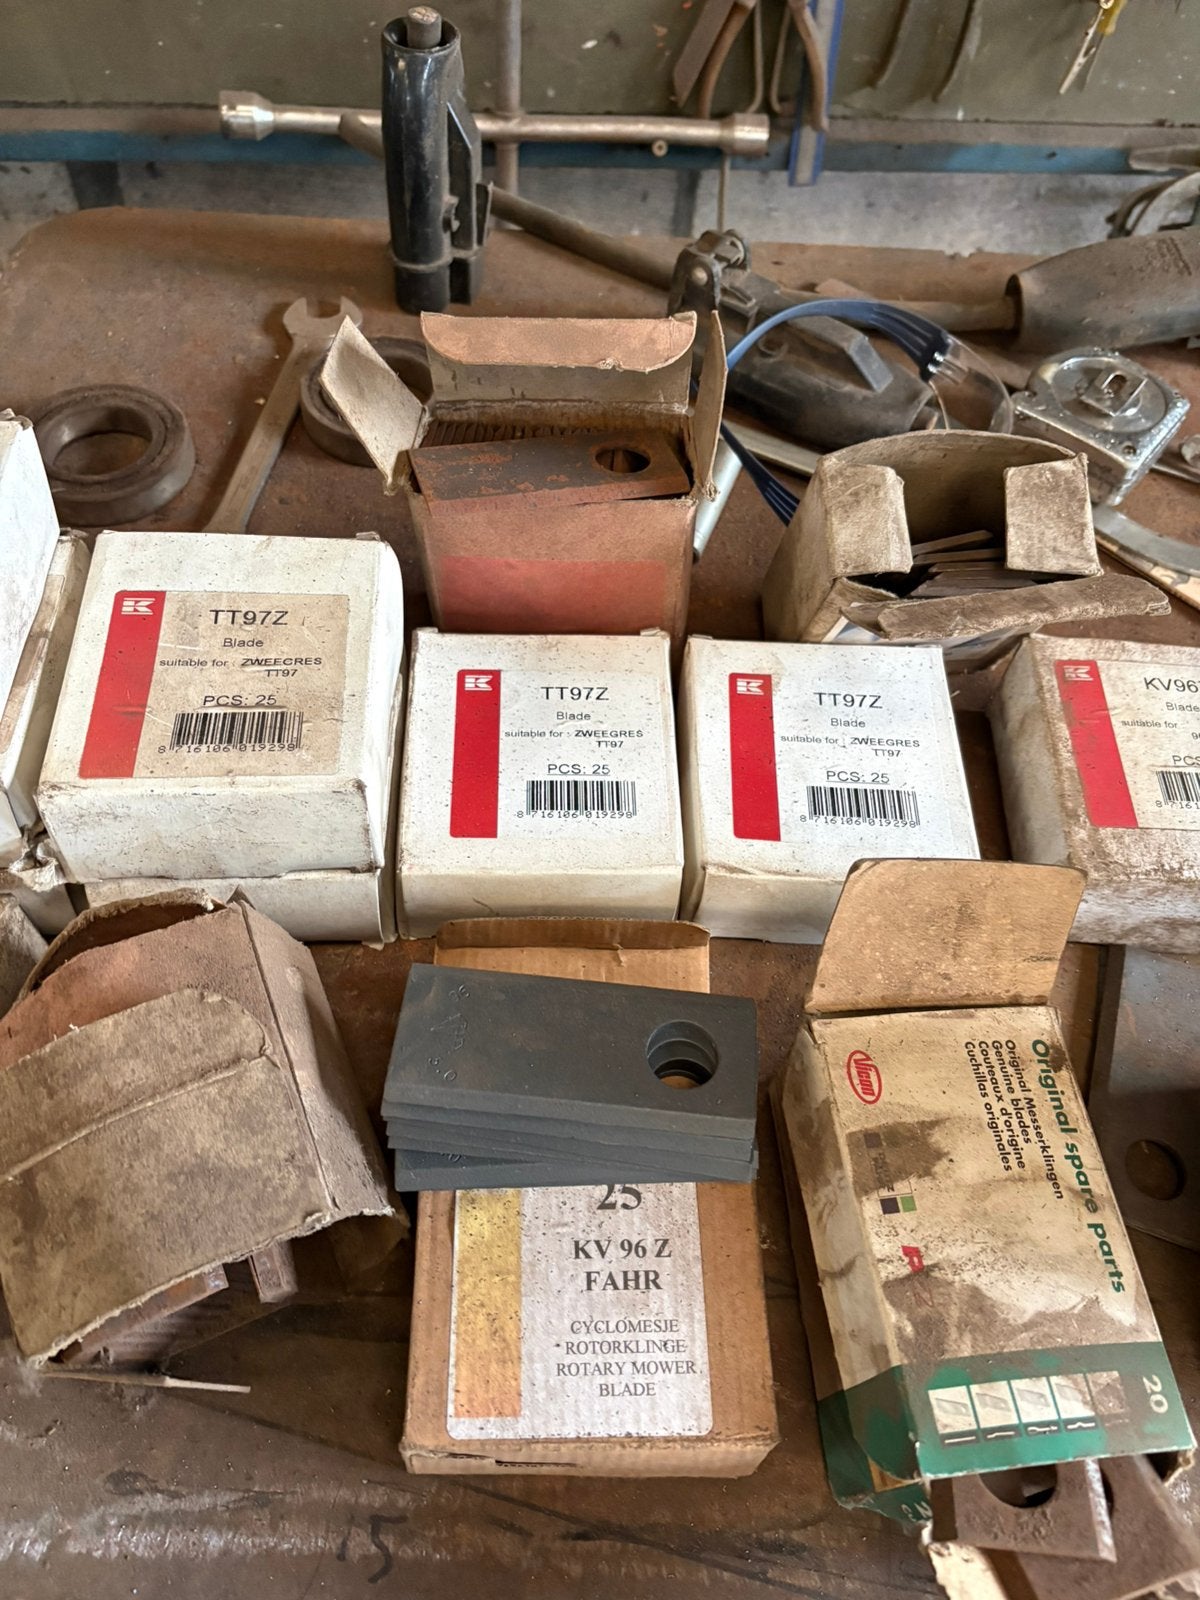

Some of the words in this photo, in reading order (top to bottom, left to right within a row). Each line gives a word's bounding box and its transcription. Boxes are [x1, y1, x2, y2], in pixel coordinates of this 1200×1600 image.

[209, 610, 289, 626] TT97Z
[222, 637, 264, 648] Blade
[159, 658, 208, 667] suitable
[265, 669, 298, 678] TT97
[1144, 677, 1200, 693] KV96
[203, 695, 248, 706] PCS:
[255, 695, 277, 706] 25
[540, 687, 609, 700] TT97Z
[813, 692, 883, 709] TT97Z
[1165, 701, 1200, 712] Blade
[556, 712, 591, 721] Blade
[830, 718, 866, 728] Blade
[1121, 720, 1161, 728] suitable
[504, 730, 546, 738] suitable
[574, 730, 644, 738] ZWEEGRES
[780, 735, 822, 744] suitable
[850, 737, 920, 747] ZWEEGRES
[873, 749, 901, 757] TT97
[547, 764, 586, 774] PCS:
[592, 764, 611, 775] 25
[826, 771, 865, 782] PCS:
[871, 772, 890, 784] 25
[991, 1040, 1015, 1094] Genuine
[1010, 1098, 1032, 1144] blades
[964, 1041, 989, 1098] Cuchillas
[984, 1102, 1012, 1172] originales
[978, 1040, 1004, 1103] Couteaux
[1000, 1107, 1026, 1170] d'origine
[1005, 1039, 1032, 1093] Original
[1024, 1096, 1064, 1199] Messerklingen
[1031, 1039, 1078, 1135] Original
[1064, 1142, 1099, 1214] spare
[1086, 1223, 1125, 1293] parts
[596, 1184, 643, 1210] 25
[573, 1240, 612, 1260] KV
[620, 1239, 648, 1259] 96
[654, 1238, 672, 1258] Z
[585, 1270, 663, 1291] FAHR
[570, 1320, 679, 1335] CYCLOMESJE
[565, 1339, 687, 1355] ROTORKLINGE
[556, 1362, 627, 1377] ROTARY
[631, 1360, 697, 1375] MOWER
[599, 1382, 657, 1397] BLADE
[1142, 1374, 1169, 1414] 20
